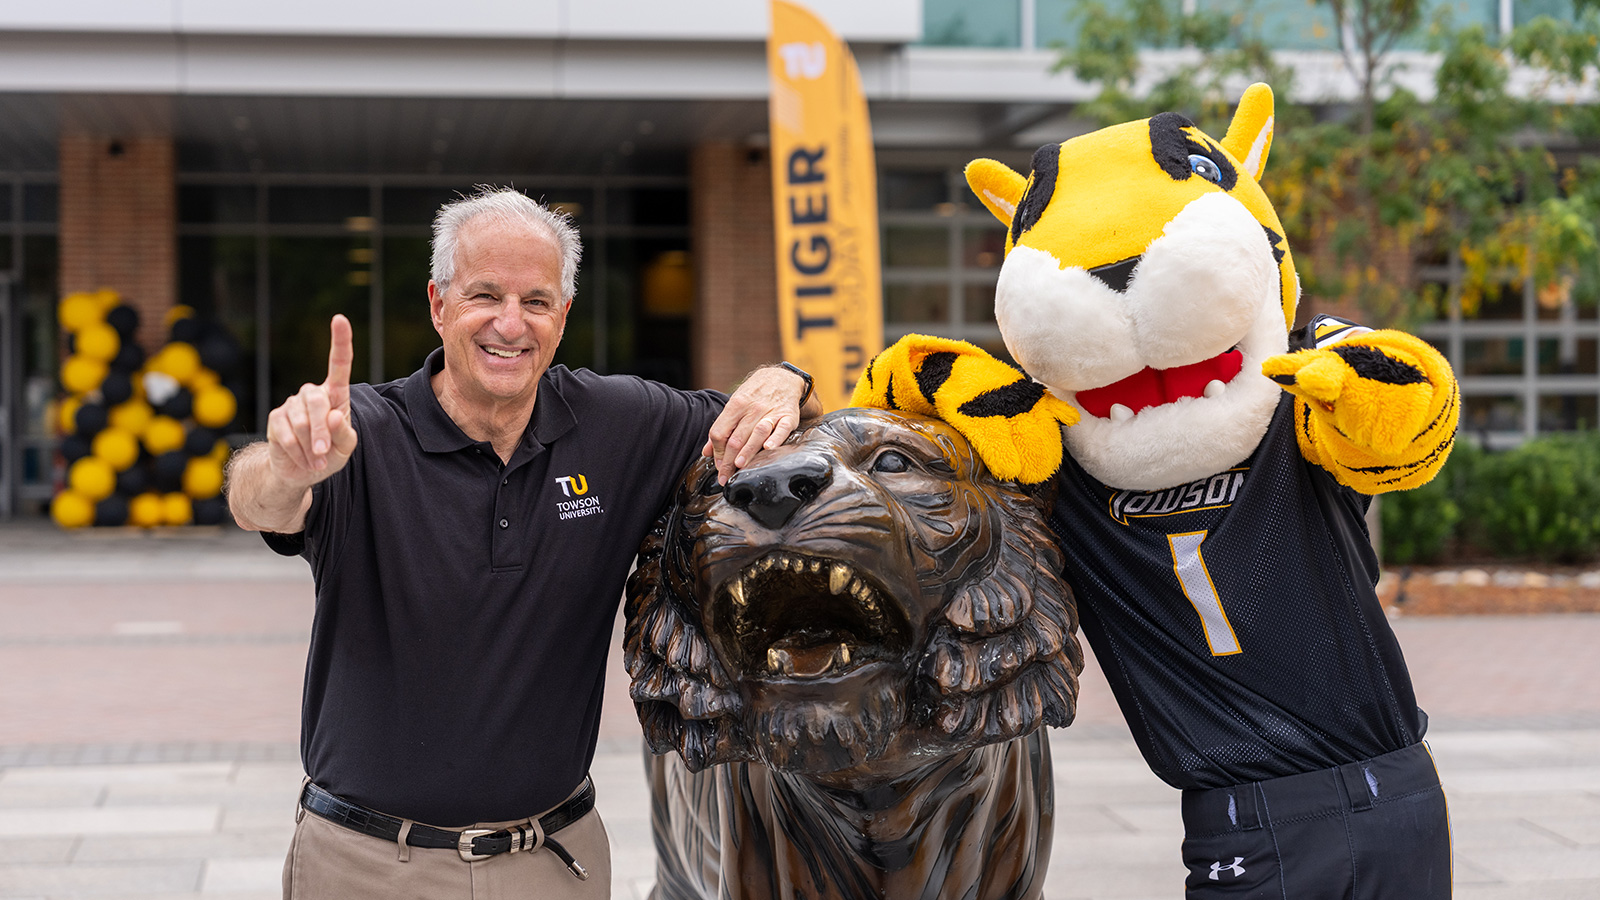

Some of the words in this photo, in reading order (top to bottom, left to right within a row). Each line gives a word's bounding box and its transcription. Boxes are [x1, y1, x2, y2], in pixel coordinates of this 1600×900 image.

[779, 41, 826, 80] TU
[787, 143, 835, 341] TIGER
[555, 474, 588, 497] TU
[556, 496, 600, 512] TOWSON
[1166, 529, 1242, 656] 1
